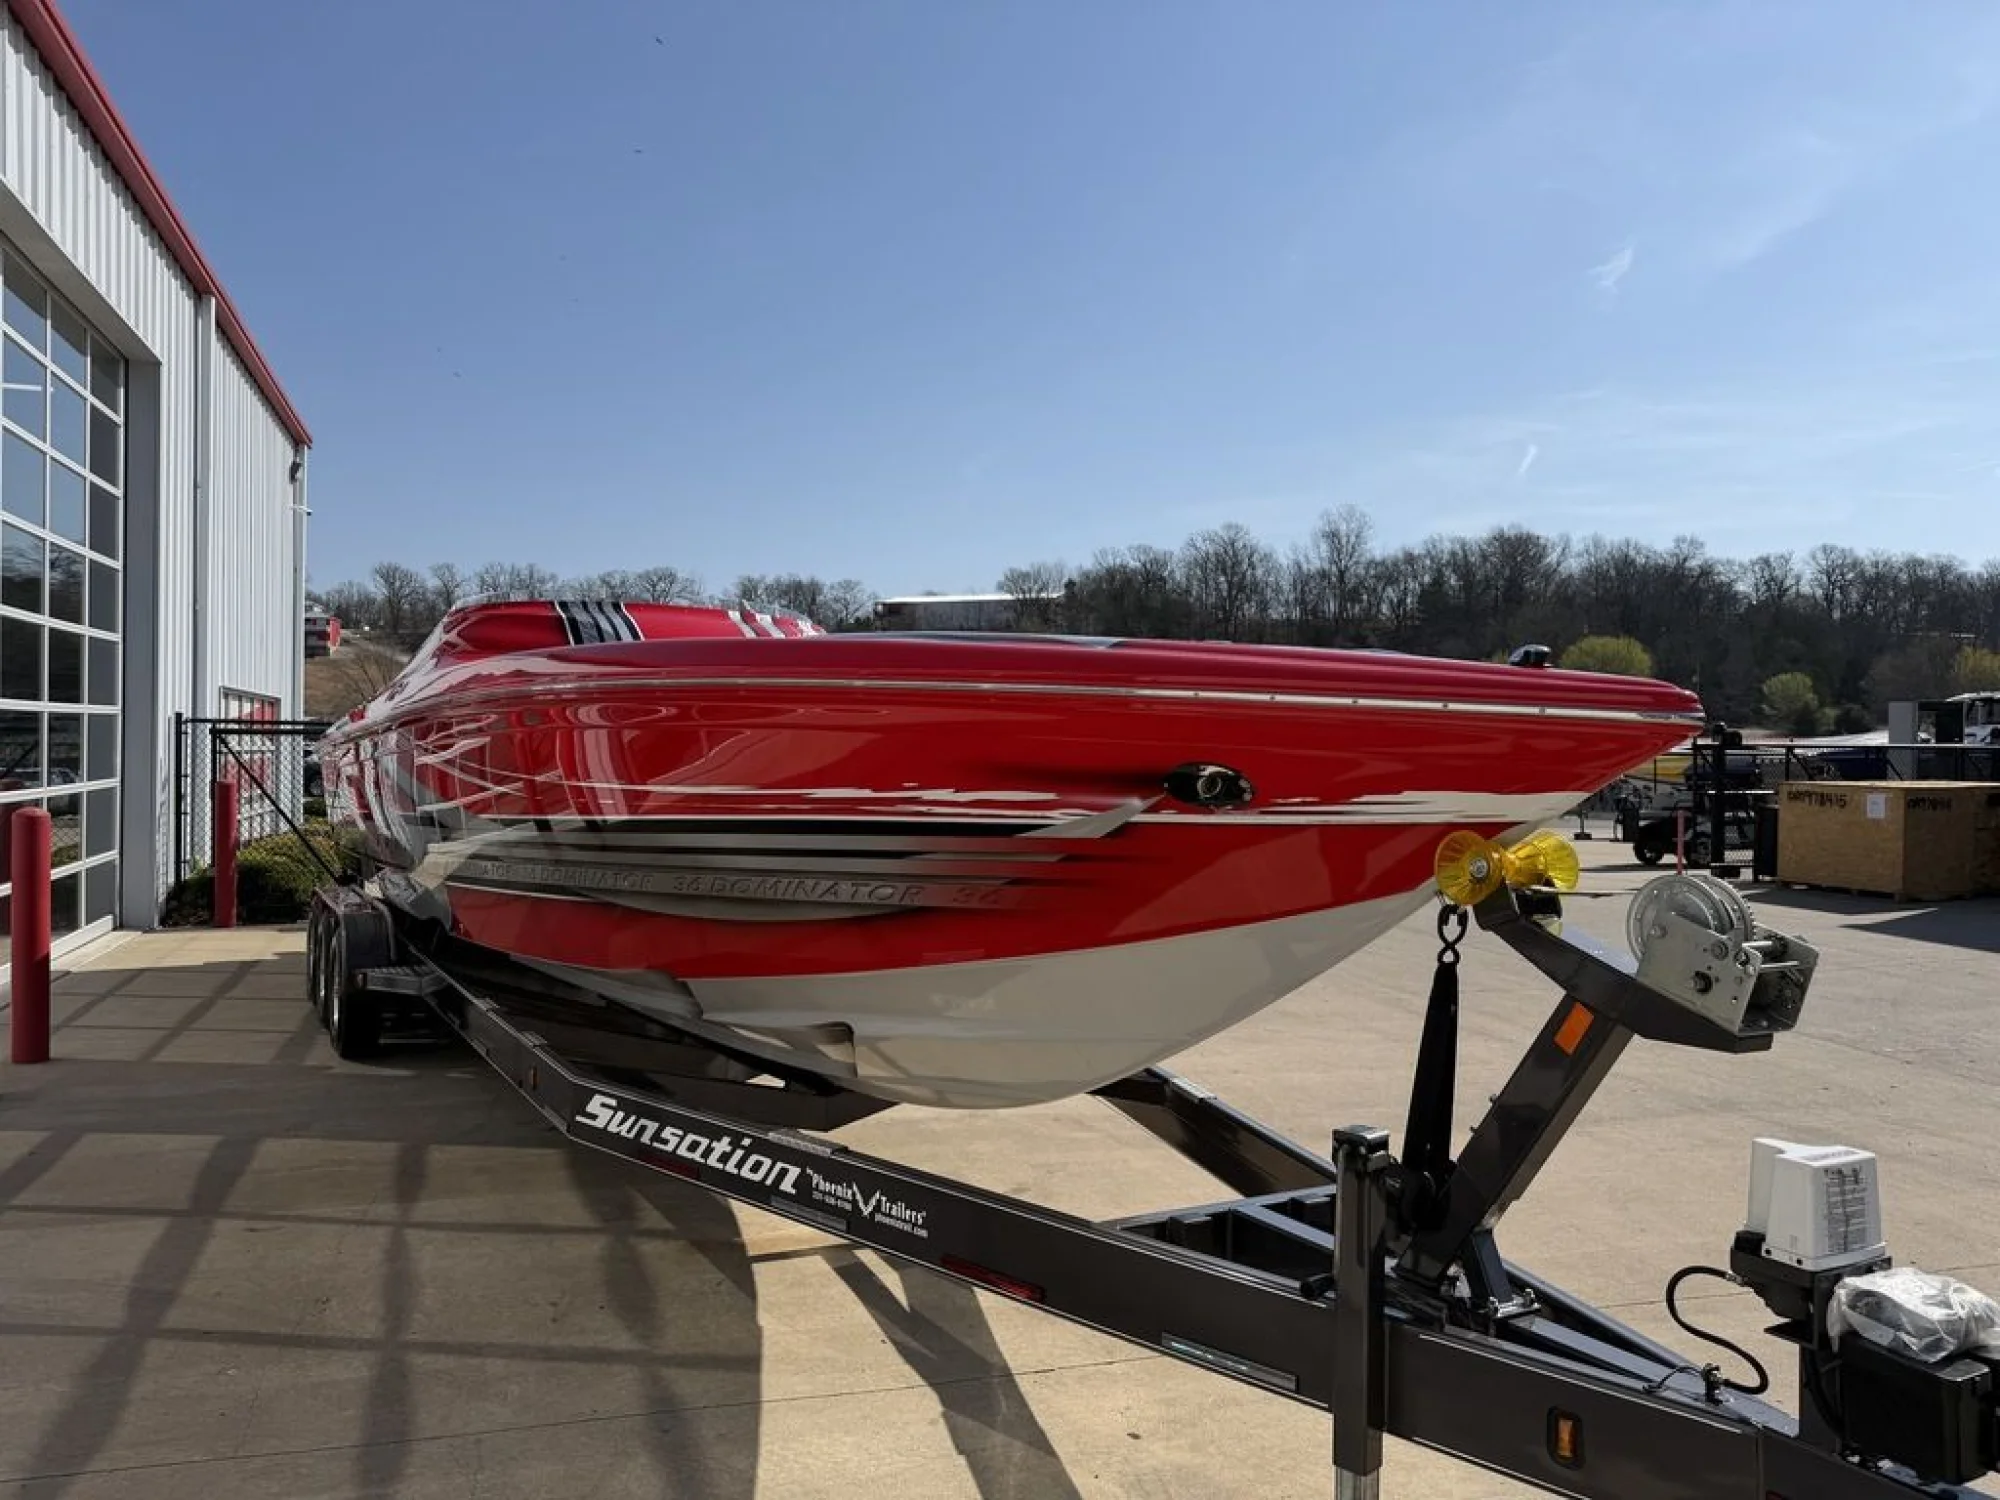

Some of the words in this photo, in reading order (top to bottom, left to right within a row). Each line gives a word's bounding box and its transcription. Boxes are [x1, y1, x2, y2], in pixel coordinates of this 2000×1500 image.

[671, 875, 702, 893] 36
[709, 874, 926, 905] DOMINATOR
[952, 886, 1003, 906] 36
[575, 1093, 802, 1195] Sunsation
[812, 1173, 852, 1201] Phoenix
[880, 1195, 924, 1226] Trailers
